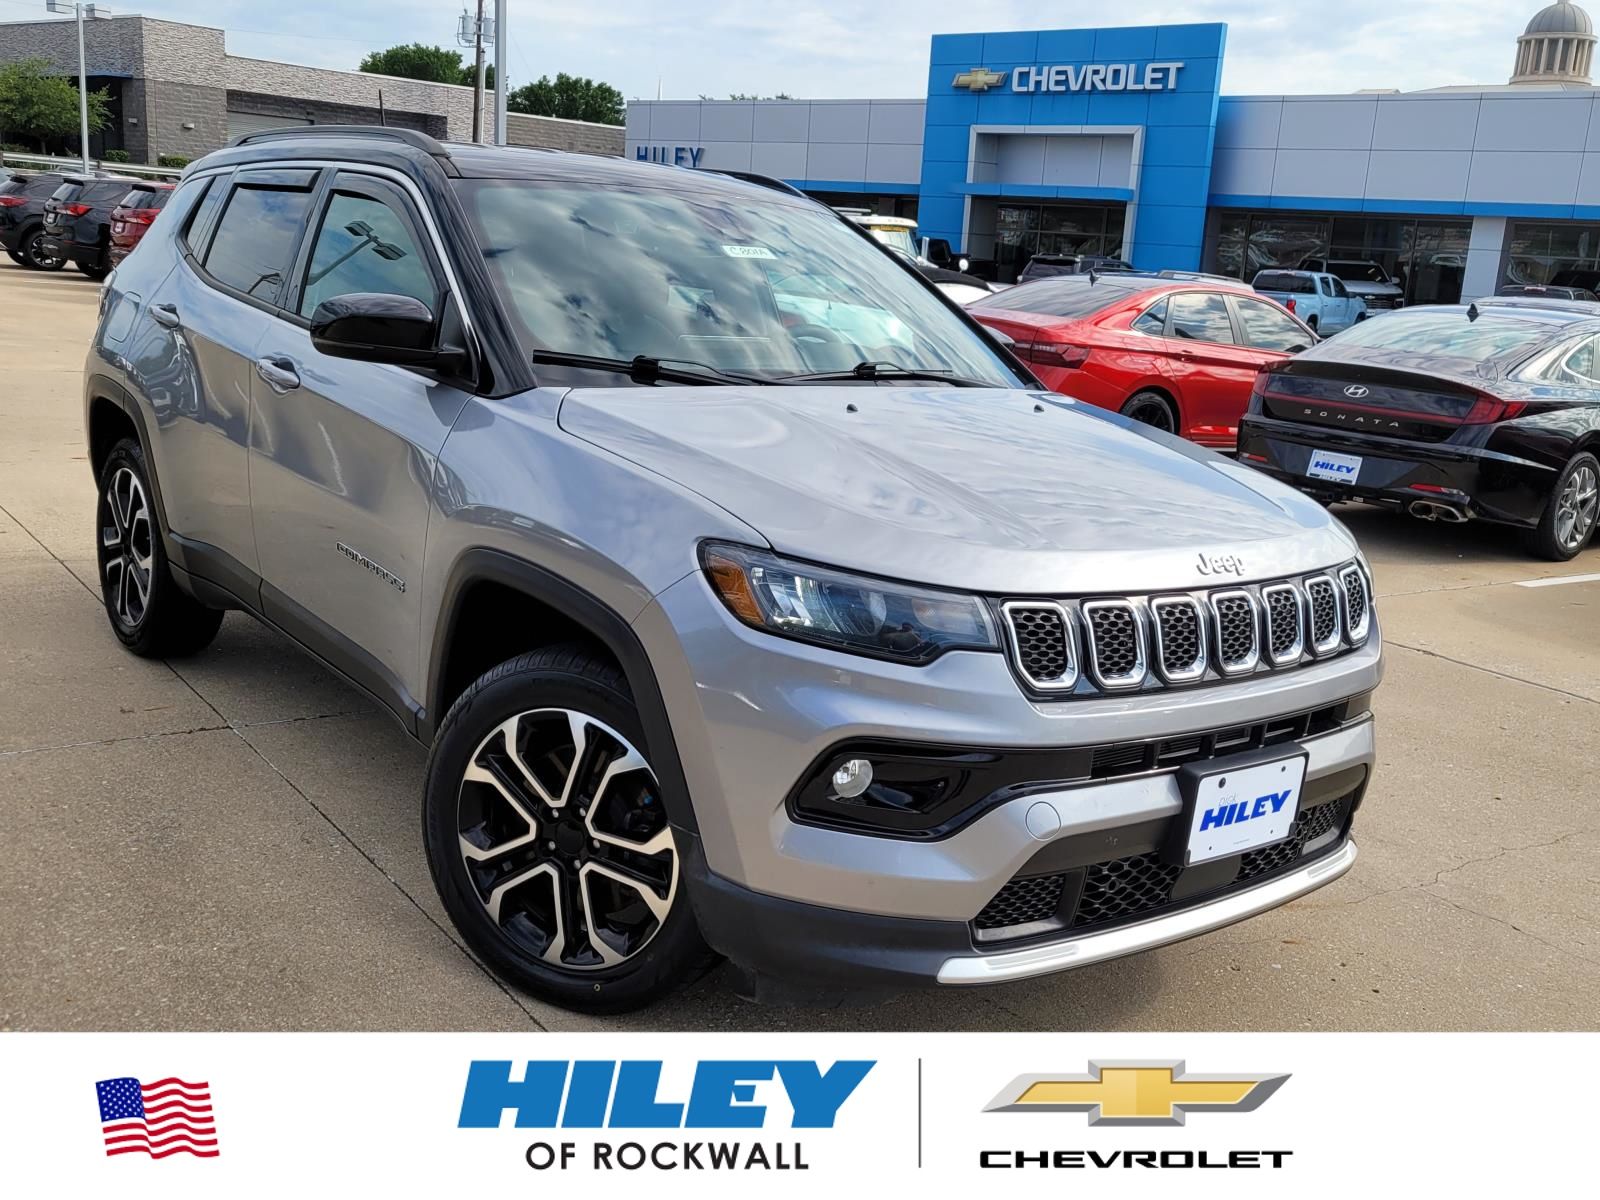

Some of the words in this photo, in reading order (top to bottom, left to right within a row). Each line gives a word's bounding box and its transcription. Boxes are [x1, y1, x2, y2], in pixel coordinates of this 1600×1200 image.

[1012, 62, 1184, 92] CHEVROLET
[1303, 408, 1399, 427] SONATA
[1313, 460, 1355, 474] HILEY
[336, 541, 406, 593] COMPASS
[1196, 552, 1245, 577] Jeep
[1199, 789, 1292, 832] HILEY
